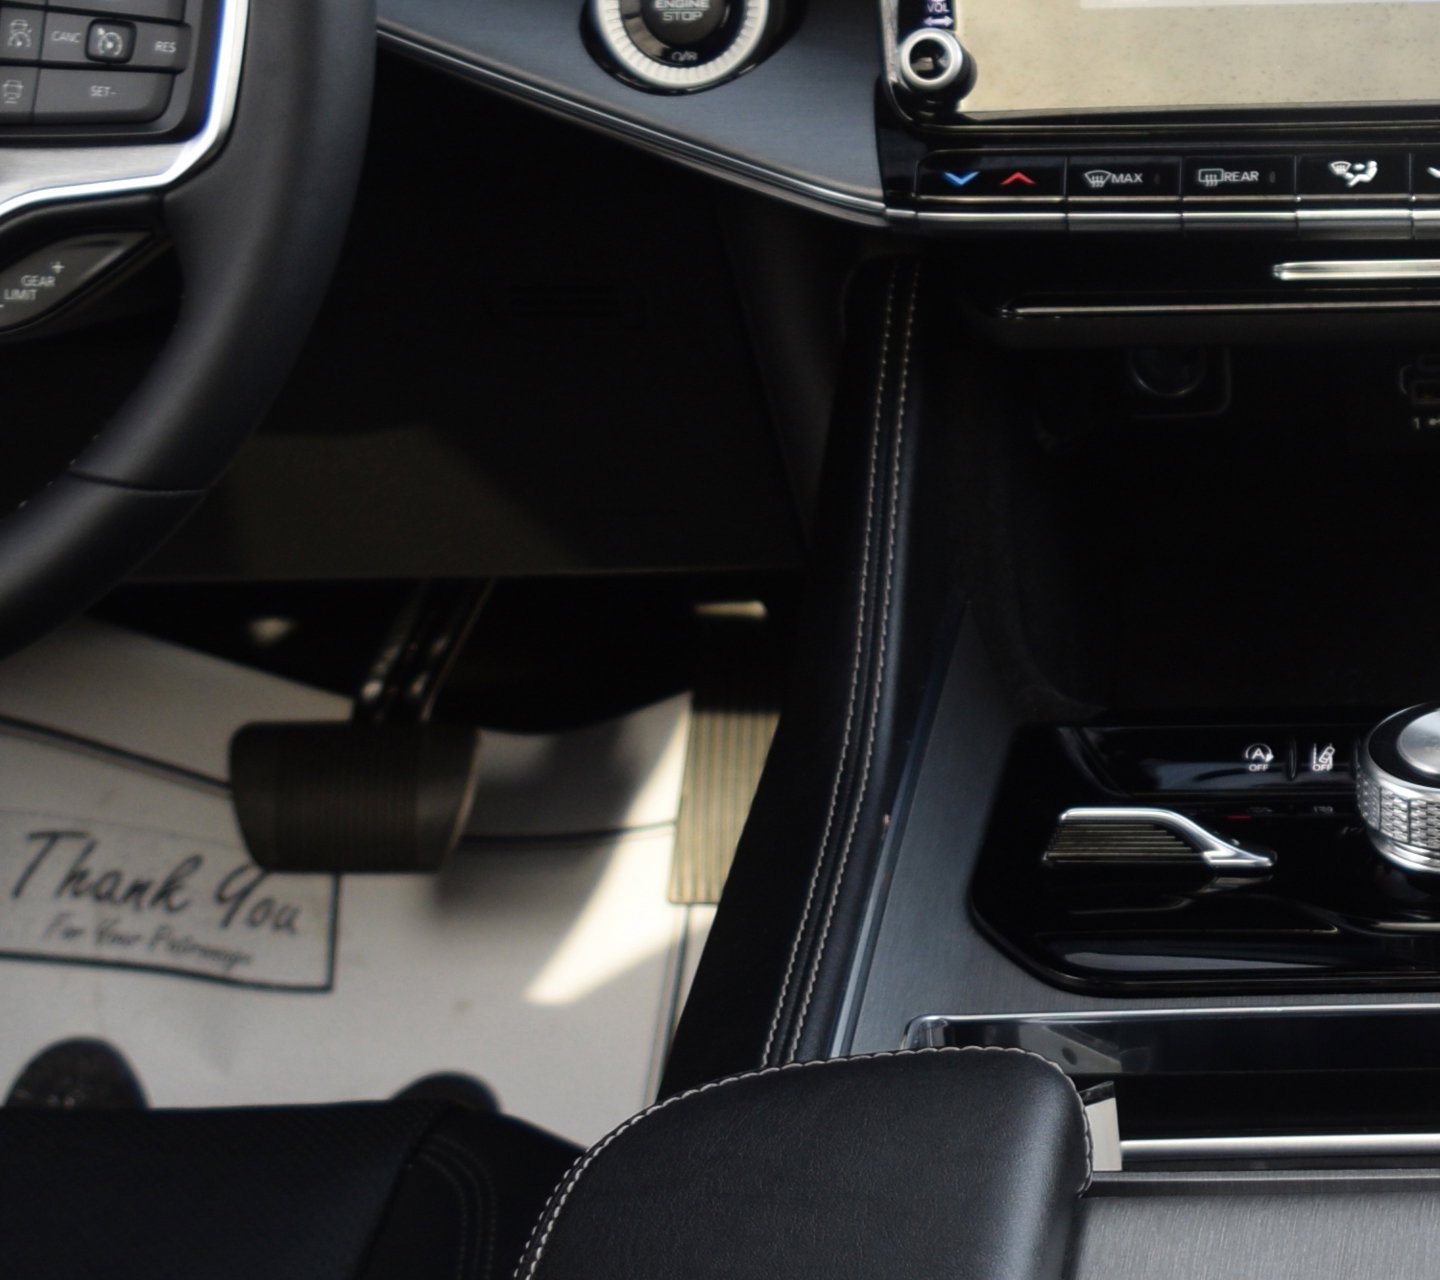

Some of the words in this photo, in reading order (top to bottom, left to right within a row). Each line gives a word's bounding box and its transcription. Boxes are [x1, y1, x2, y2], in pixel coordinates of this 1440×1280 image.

[927, 2, 951, 13] VOL
[663, 11, 703, 21] STOP
[51, 31, 81, 43] CANC
[155, 41, 177, 53] RES
[1111, 173, 1143, 185] MAX
[1223, 171, 1259, 183] REAR
[20, 275, 56, 287] GEAR
[3, 289, 38, 300] LIMIT
[1248, 764, 1269, 772] OFF
[1312, 764, 1333, 772] OFF
[12, 830, 204, 914] Thank
[213, 862, 301, 935] You
